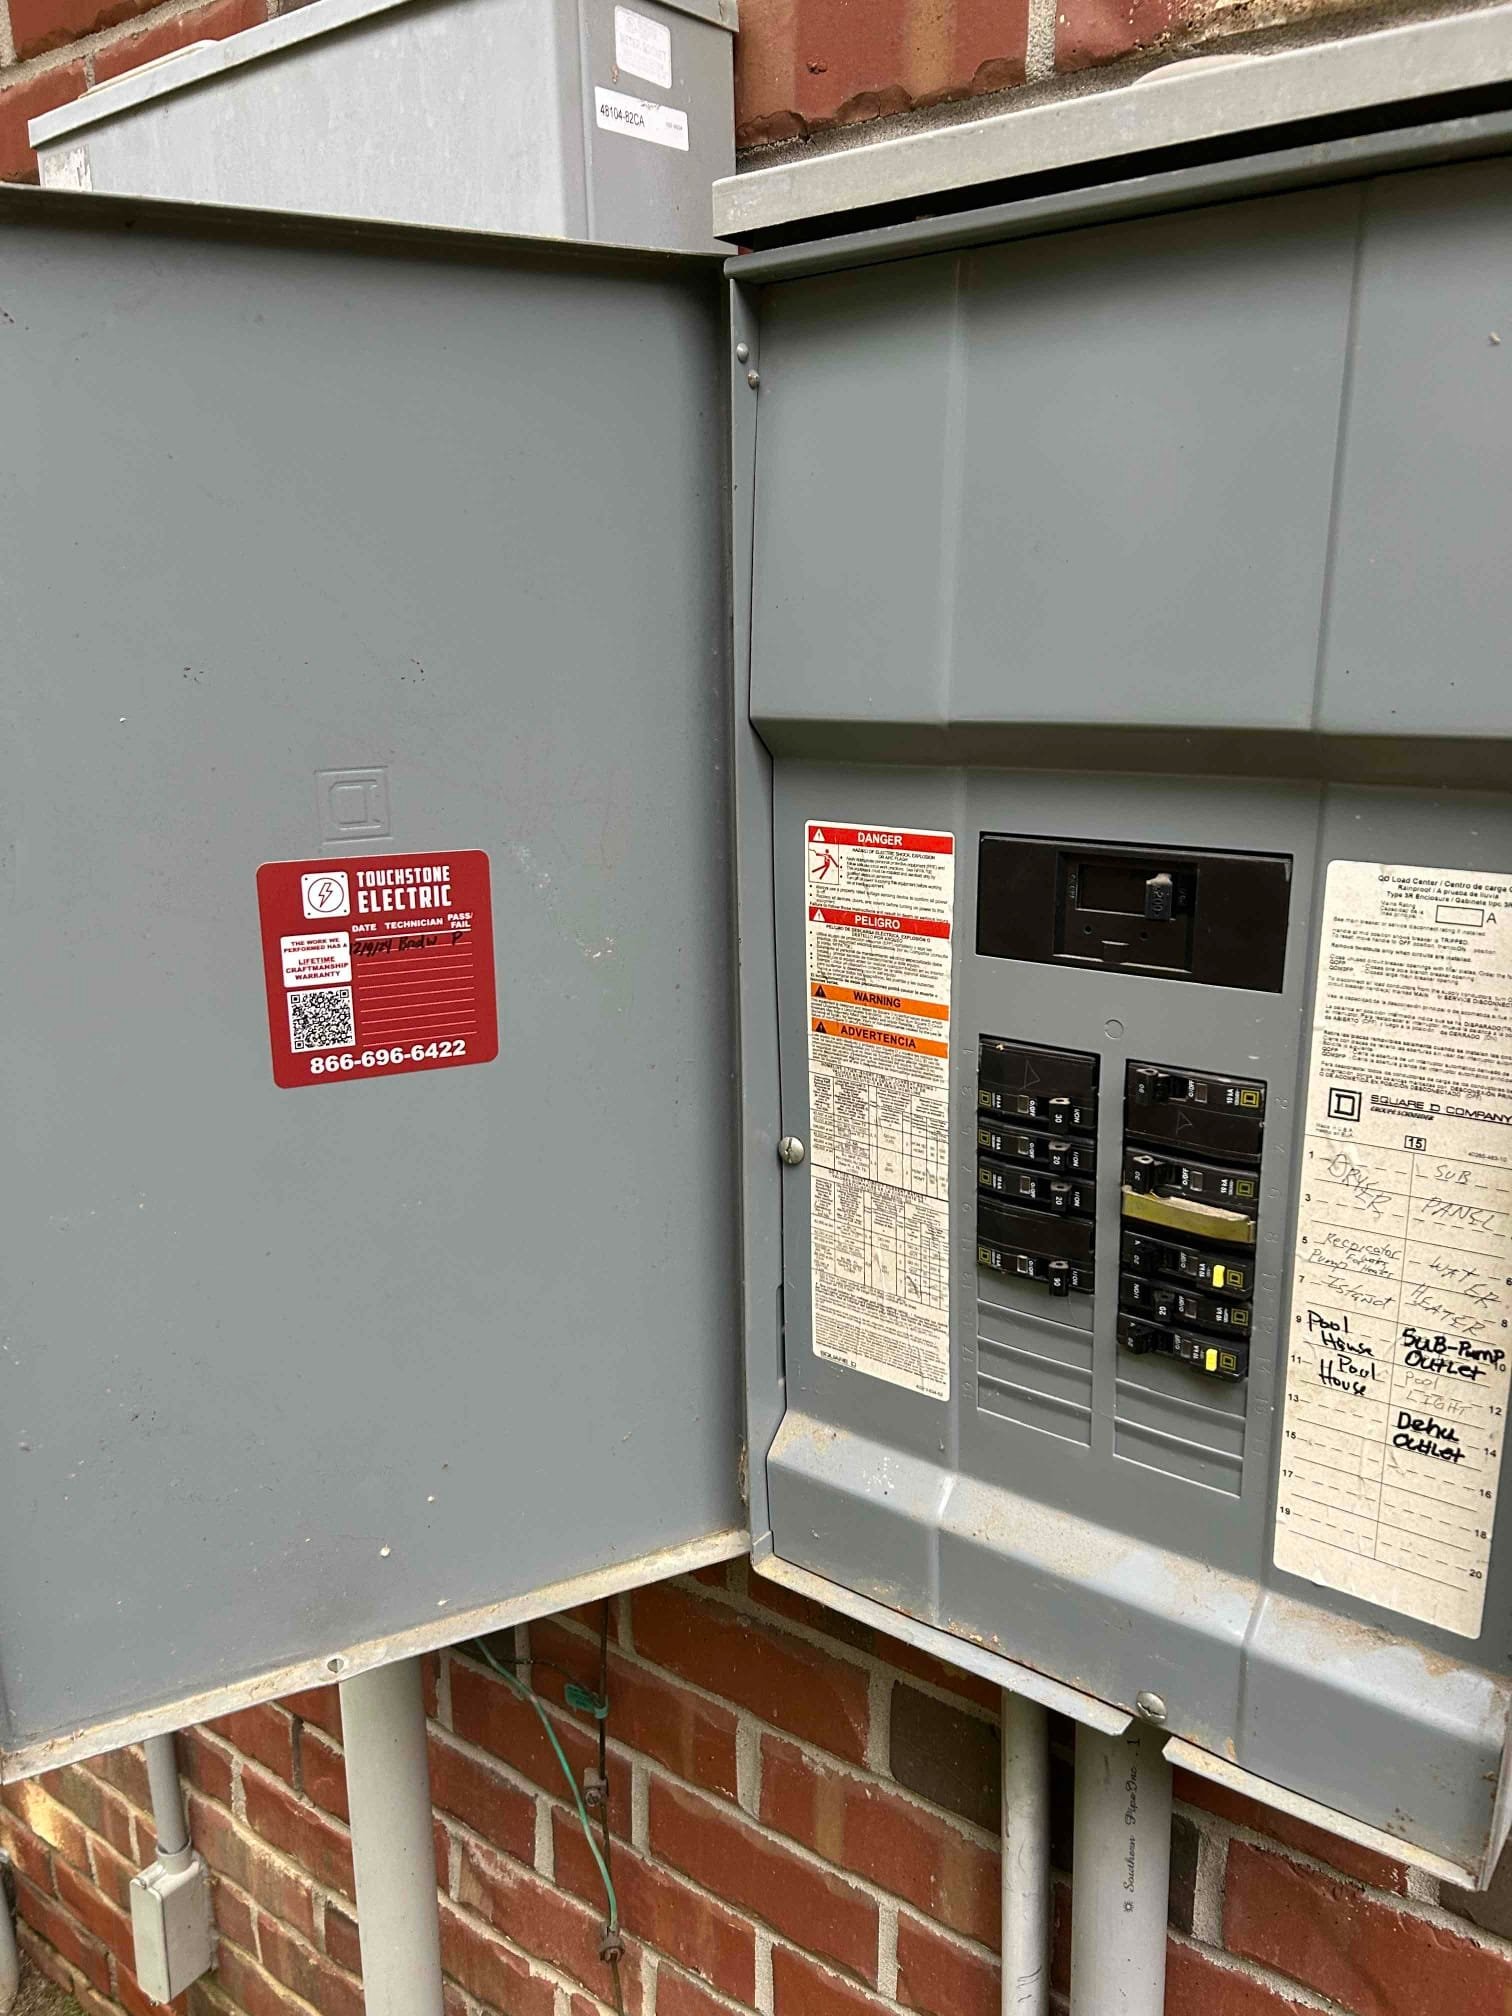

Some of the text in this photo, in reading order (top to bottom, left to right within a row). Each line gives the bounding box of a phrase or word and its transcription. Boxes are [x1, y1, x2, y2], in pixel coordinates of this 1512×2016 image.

[600, 104, 645, 127] 48104-82CA
[857, 831, 903, 846] DANGER
[357, 865, 450, 888] TOUCHSTONE
[1392, 876, 1410, 884] Load
[1413, 877, 1438, 886] Center
[1444, 880, 1471, 889] Centro
[1485, 885, 1507, 893] carga
[358, 884, 452, 913] ELECTRIC
[1387, 890, 1402, 898] Type
[854, 914, 901, 930] PELIGRO
[1486, 912, 1497, 924] A
[352, 918, 443, 932] DATE TECHNICIAN
[451, 920, 471, 928] FAIL
[283, 944, 326, 953] PERFORMED
[298, 956, 336, 966] LIFETIME
[295, 970, 341, 980] WARRANTY
[853, 990, 901, 1008] WARNING
[840, 1025, 916, 1049] ADVERTENCIA
[310, 1039, 467, 1075] 866-696-6422
[1370, 1094, 1512, 1123] SQUARE D COMPANY
[1409, 1137, 1422, 1149] 15
[1053, 1155, 1061, 1165] 20
[1309, 1151, 1314, 1159] 1
[1055, 1196, 1063, 1205] 20
[1305, 1194, 1311, 1202] 3
[1302, 1236, 1308, 1244] 5
[1299, 1275, 1305, 1283] 7
[1506, 1277, 1512, 1286] 6
[1159, 1305, 1167, 1316] 20
[1296, 1315, 1302, 1323] 9
[1307, 1309, 1348, 1333] Pool
[1501, 1319, 1508, 1328] 8
[1291, 1355, 1302, 1363] 11
[1494, 1361, 1506, 1372] 10
[1288, 1393, 1299, 1403] 13
[1489, 1405, 1503, 1416] 12
[1285, 1430, 1297, 1440] 15
[1484, 1447, 1497, 1457] 14
[1282, 1469, 1293, 1478] 17
[1479, 1488, 1492, 1499] 16
[1280, 1506, 1291, 1516] 19
[1474, 1529, 1487, 1540] 18
[1469, 1568, 1483, 1580] 20
[1123, 1834, 1136, 1893] Southern
